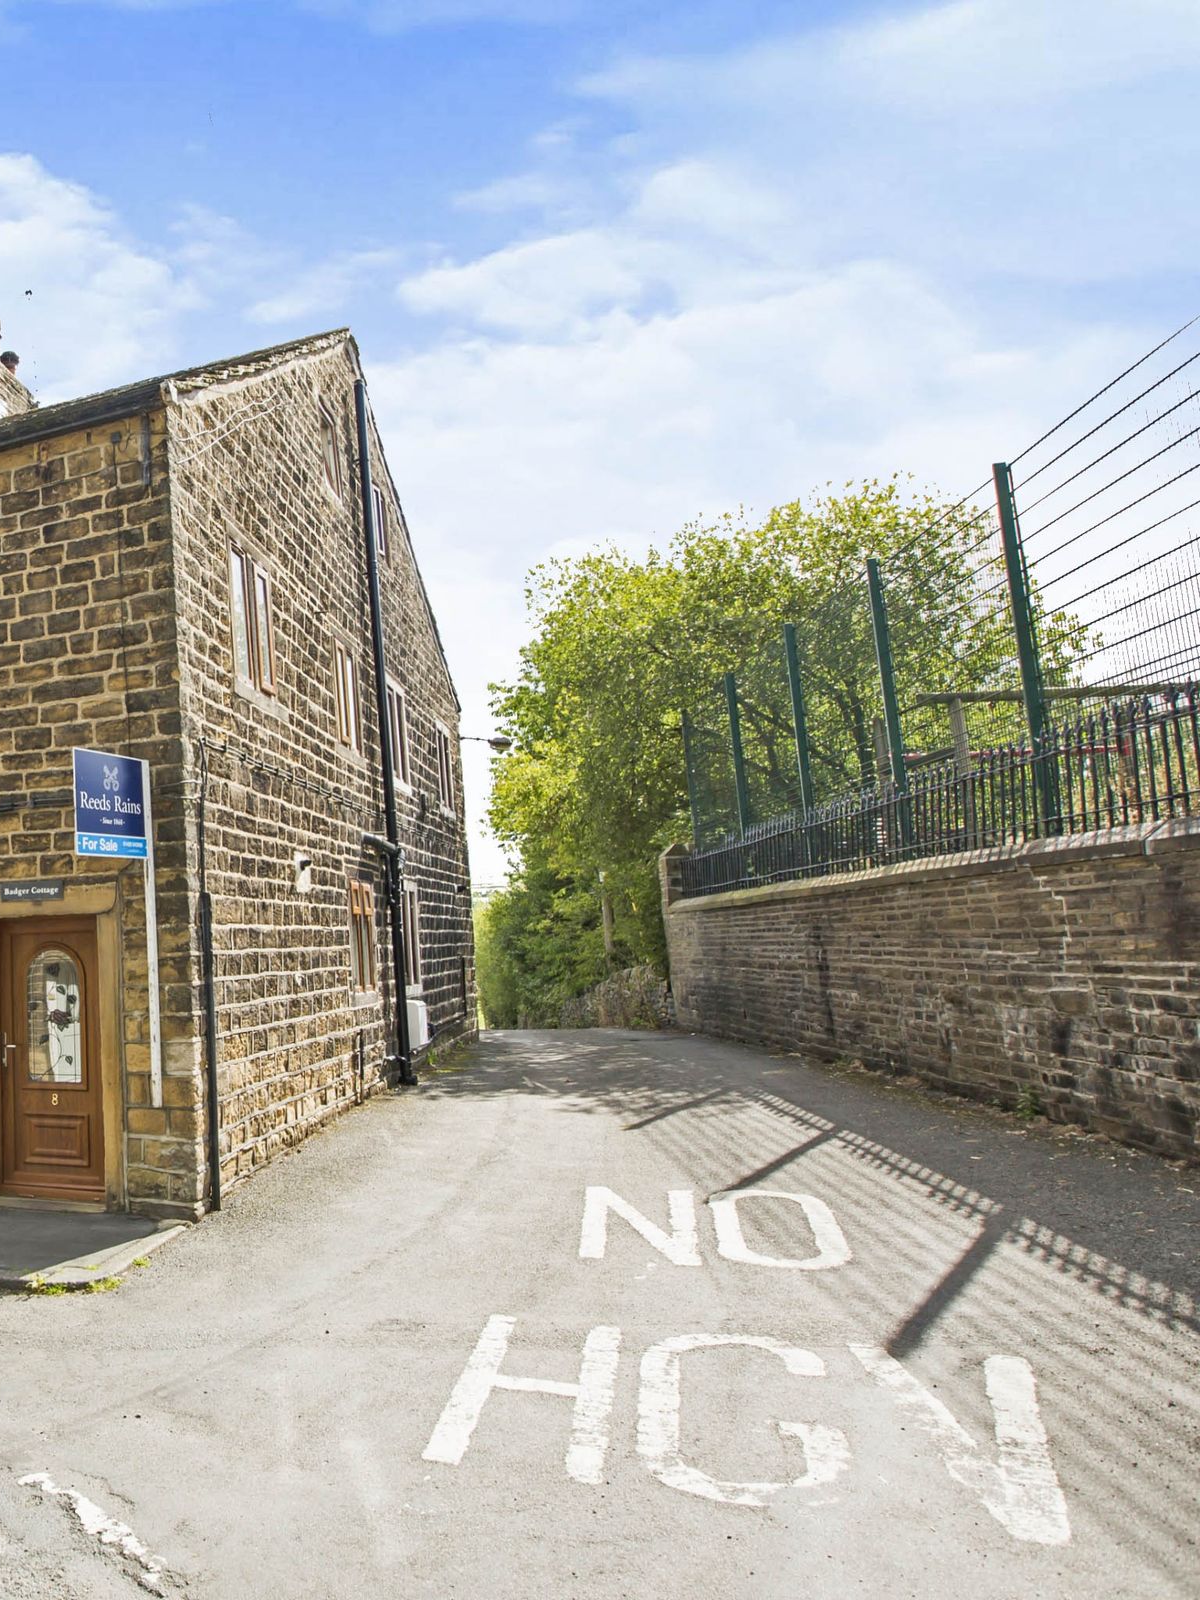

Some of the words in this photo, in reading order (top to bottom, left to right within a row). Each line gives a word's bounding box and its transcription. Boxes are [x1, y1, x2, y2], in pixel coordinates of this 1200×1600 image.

[80, 791, 111, 811] Reeds
[114, 795, 142, 815] Rains
[82, 836, 98, 850] For
[99, 838, 118, 852] Sale
[4, 887, 30, 897] Badger
[31, 886, 59, 896] Cottage
[51, 1093, 59, 1106] 8
[578, 1185, 853, 1271] NO
[421, 1314, 1072, 1546] HGV
